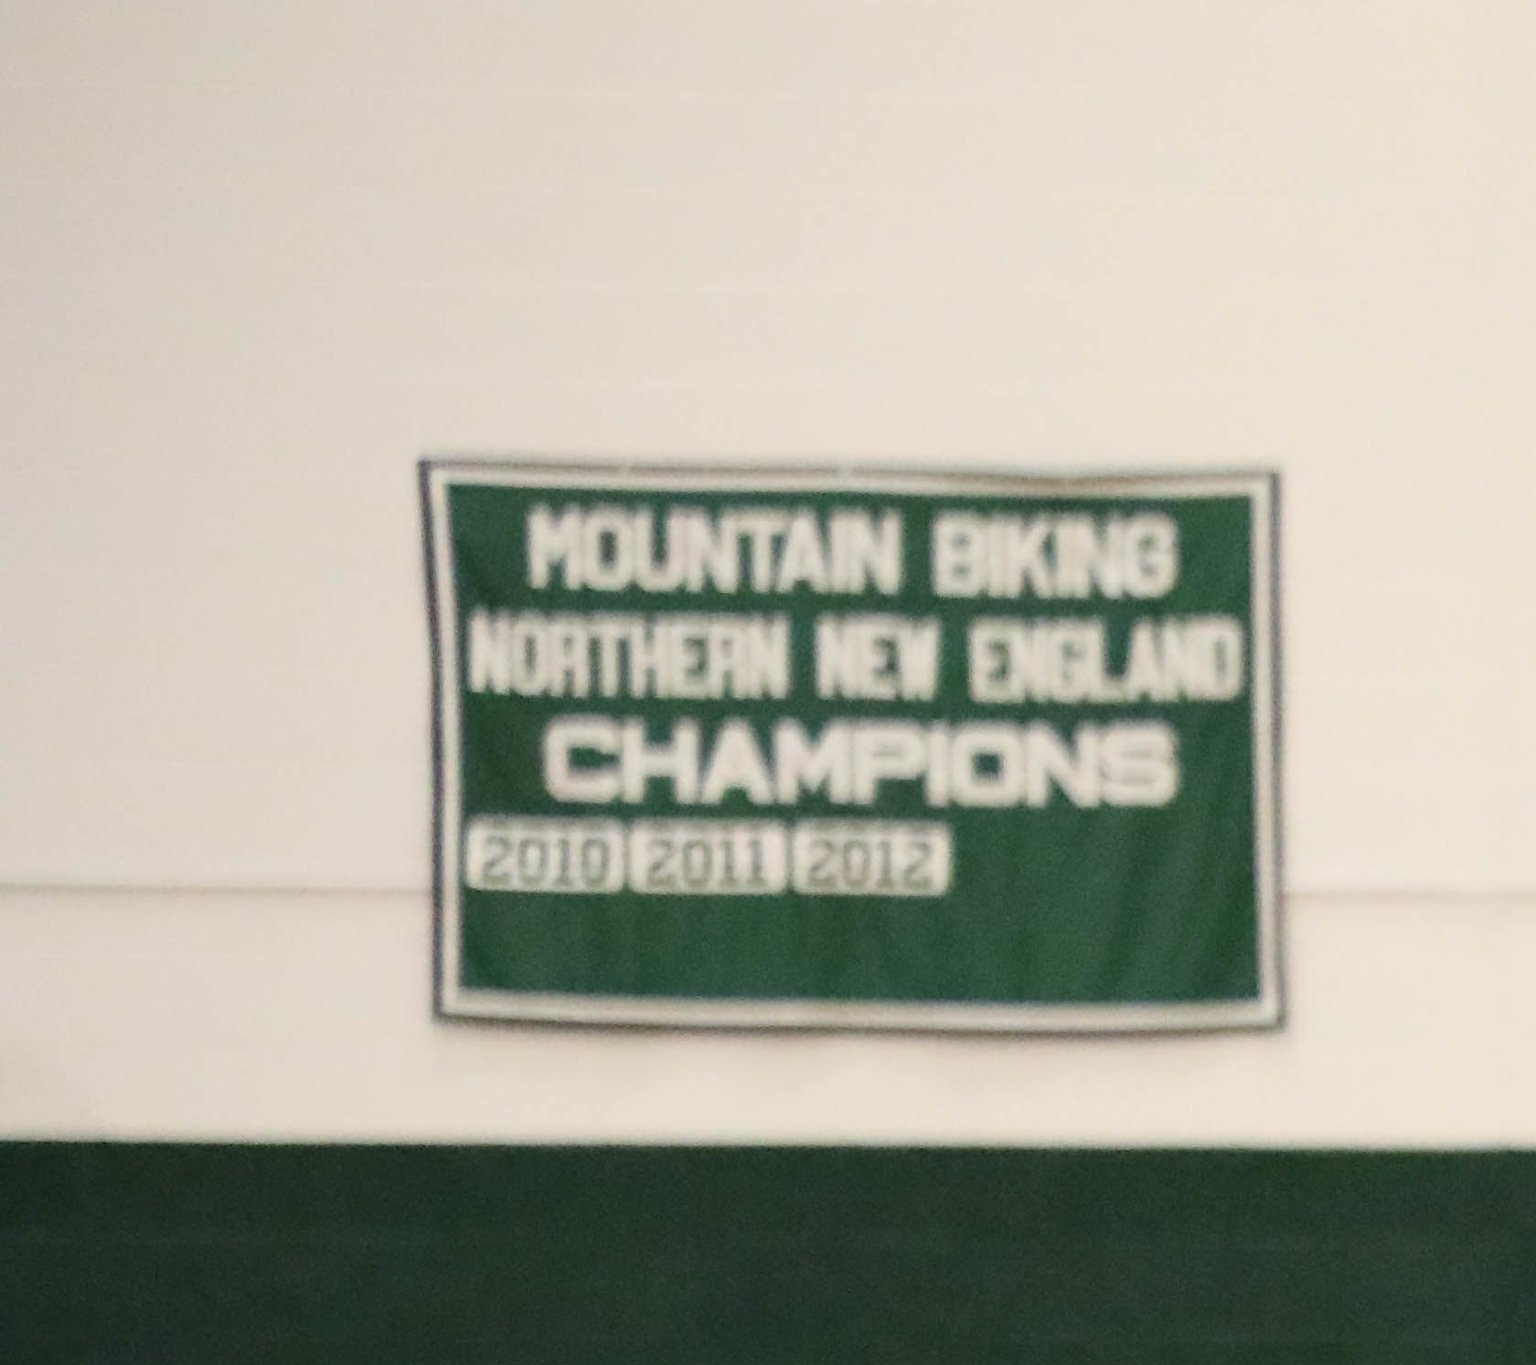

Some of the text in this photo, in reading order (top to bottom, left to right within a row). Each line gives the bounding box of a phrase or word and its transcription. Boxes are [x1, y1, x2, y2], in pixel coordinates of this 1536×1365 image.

[526, 504, 1177, 600] MOUNTAIN BIKING
[468, 611, 1246, 706] NORTHERN NEW ENGLAND
[541, 714, 1181, 809] CHAMPIONS
[479, 836, 934, 890] 2010 2011 2012
